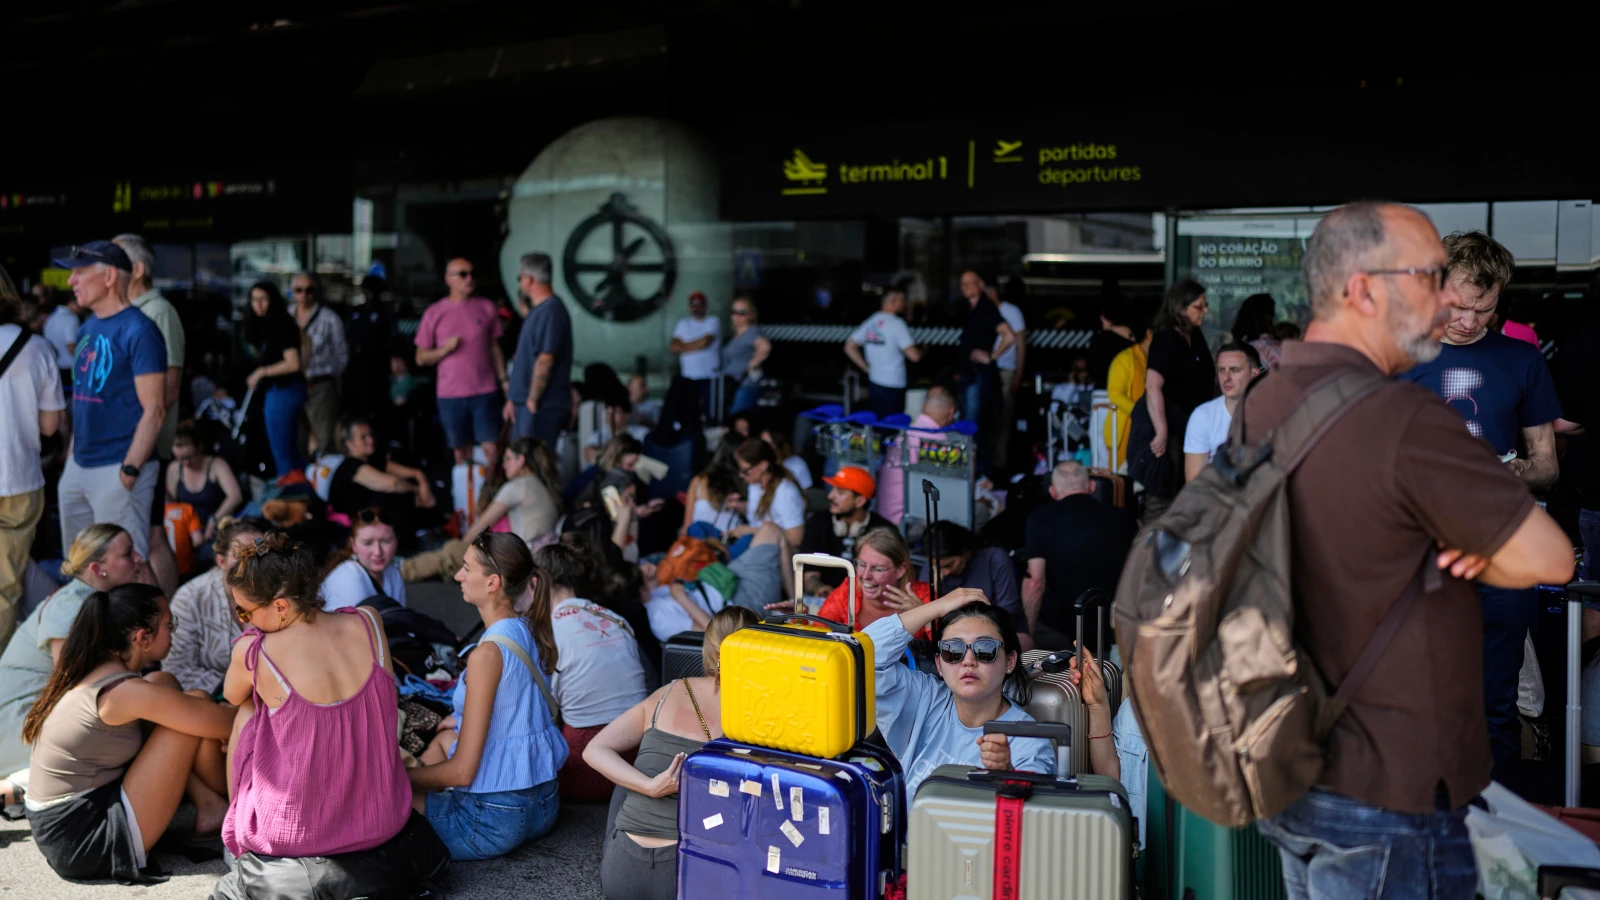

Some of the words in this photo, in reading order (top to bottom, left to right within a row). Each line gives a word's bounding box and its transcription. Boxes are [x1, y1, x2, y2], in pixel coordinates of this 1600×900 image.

[1039, 142, 1117, 166] partidas
[839, 158, 934, 183] terminal
[938, 155, 948, 179] 1
[1038, 165, 1142, 187] departures
[1199, 243, 1217, 255] NO
[1219, 240, 1278, 256] CORAÇÃO
[1198, 256, 1217, 268] DO
[1219, 256, 1263, 268] BAIRRO
[1003, 809, 1014, 853] pierre
[785, 870, 817, 880] TOURISTER
[786, 867, 818, 877] AMERICAN
